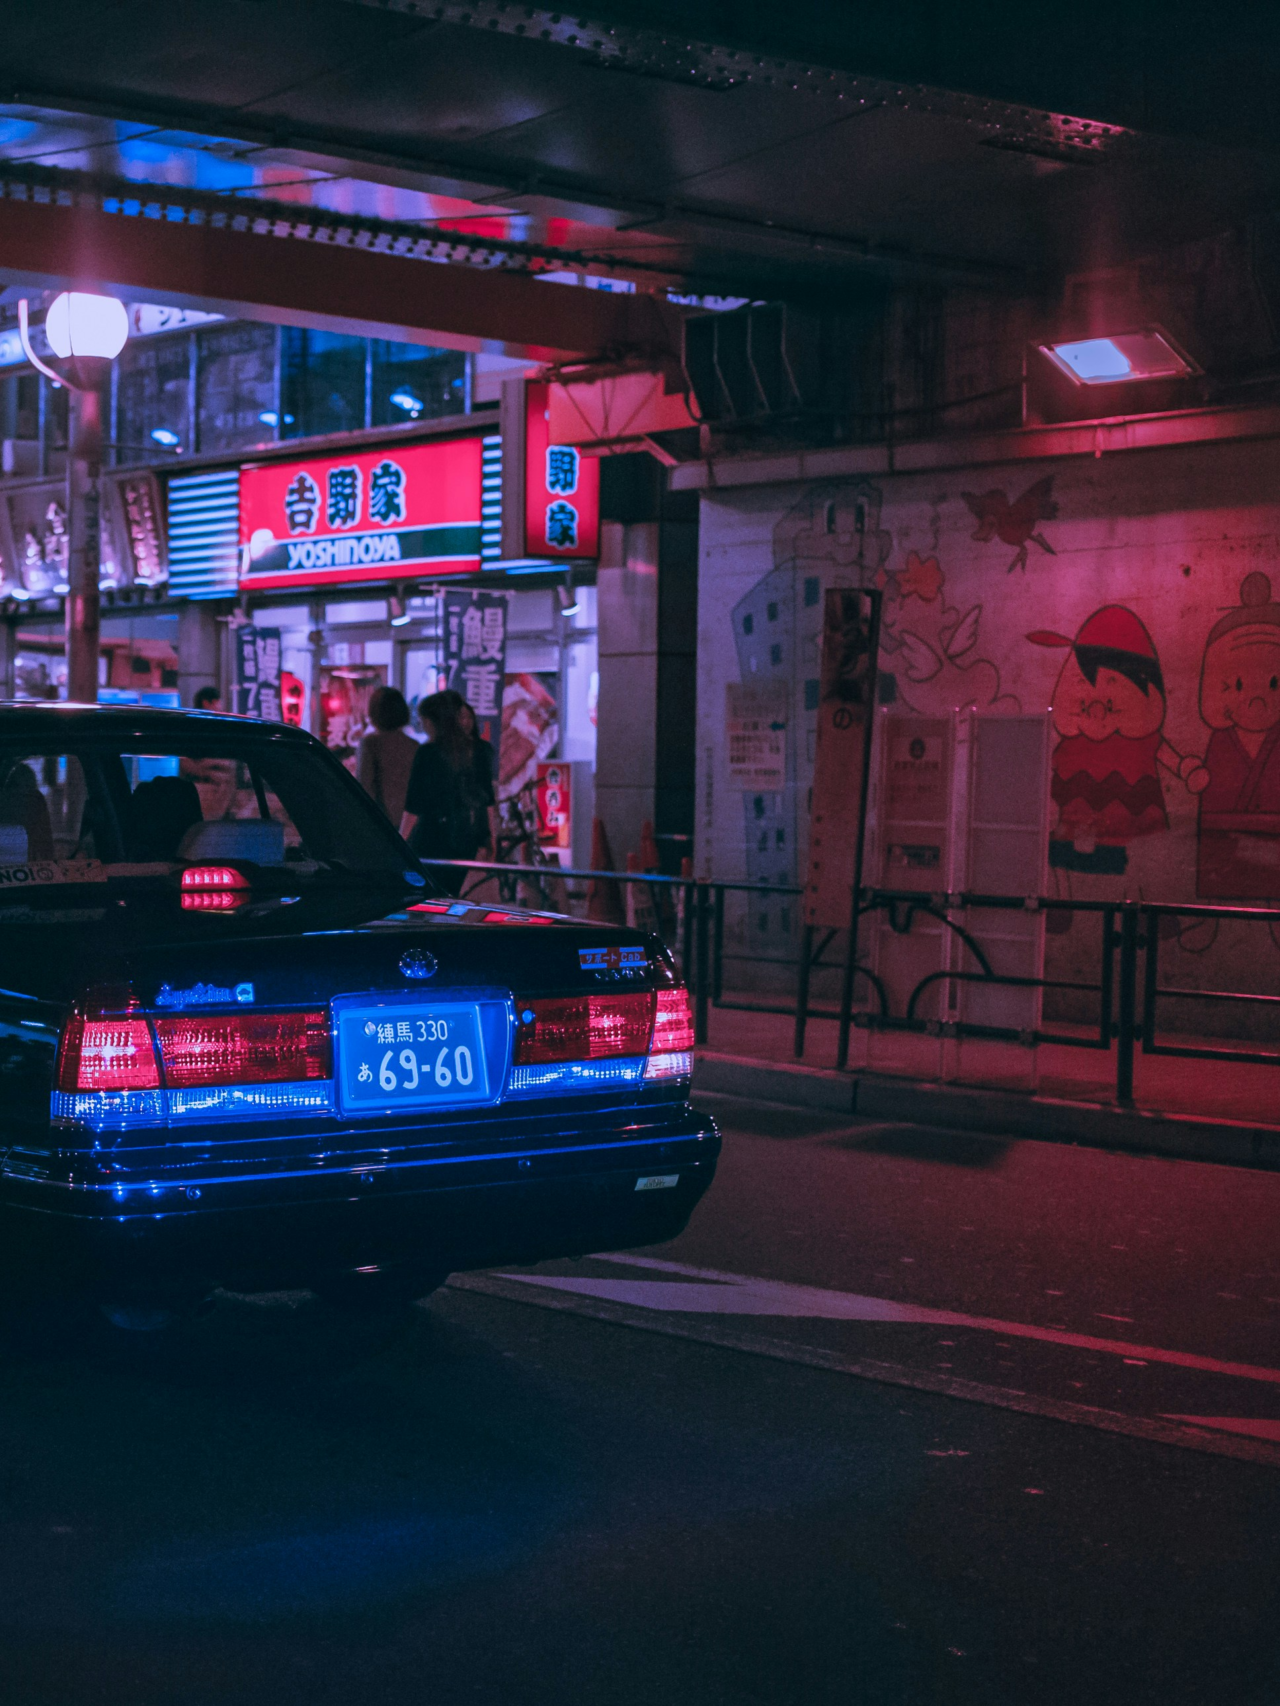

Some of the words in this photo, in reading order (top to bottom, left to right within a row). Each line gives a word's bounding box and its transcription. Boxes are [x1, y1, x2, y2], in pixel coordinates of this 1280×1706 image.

[285, 459, 408, 536] 吉野家
[287, 534, 401, 569] YOSHINOYA
[586, 953, 617, 963] サポート
[621, 952, 640, 962] Cab
[377, 1022, 413, 1044] 練馬
[416, 1019, 448, 1042] 330
[357, 1062, 373, 1083] あ
[379, 1045, 473, 1092] 69-60
